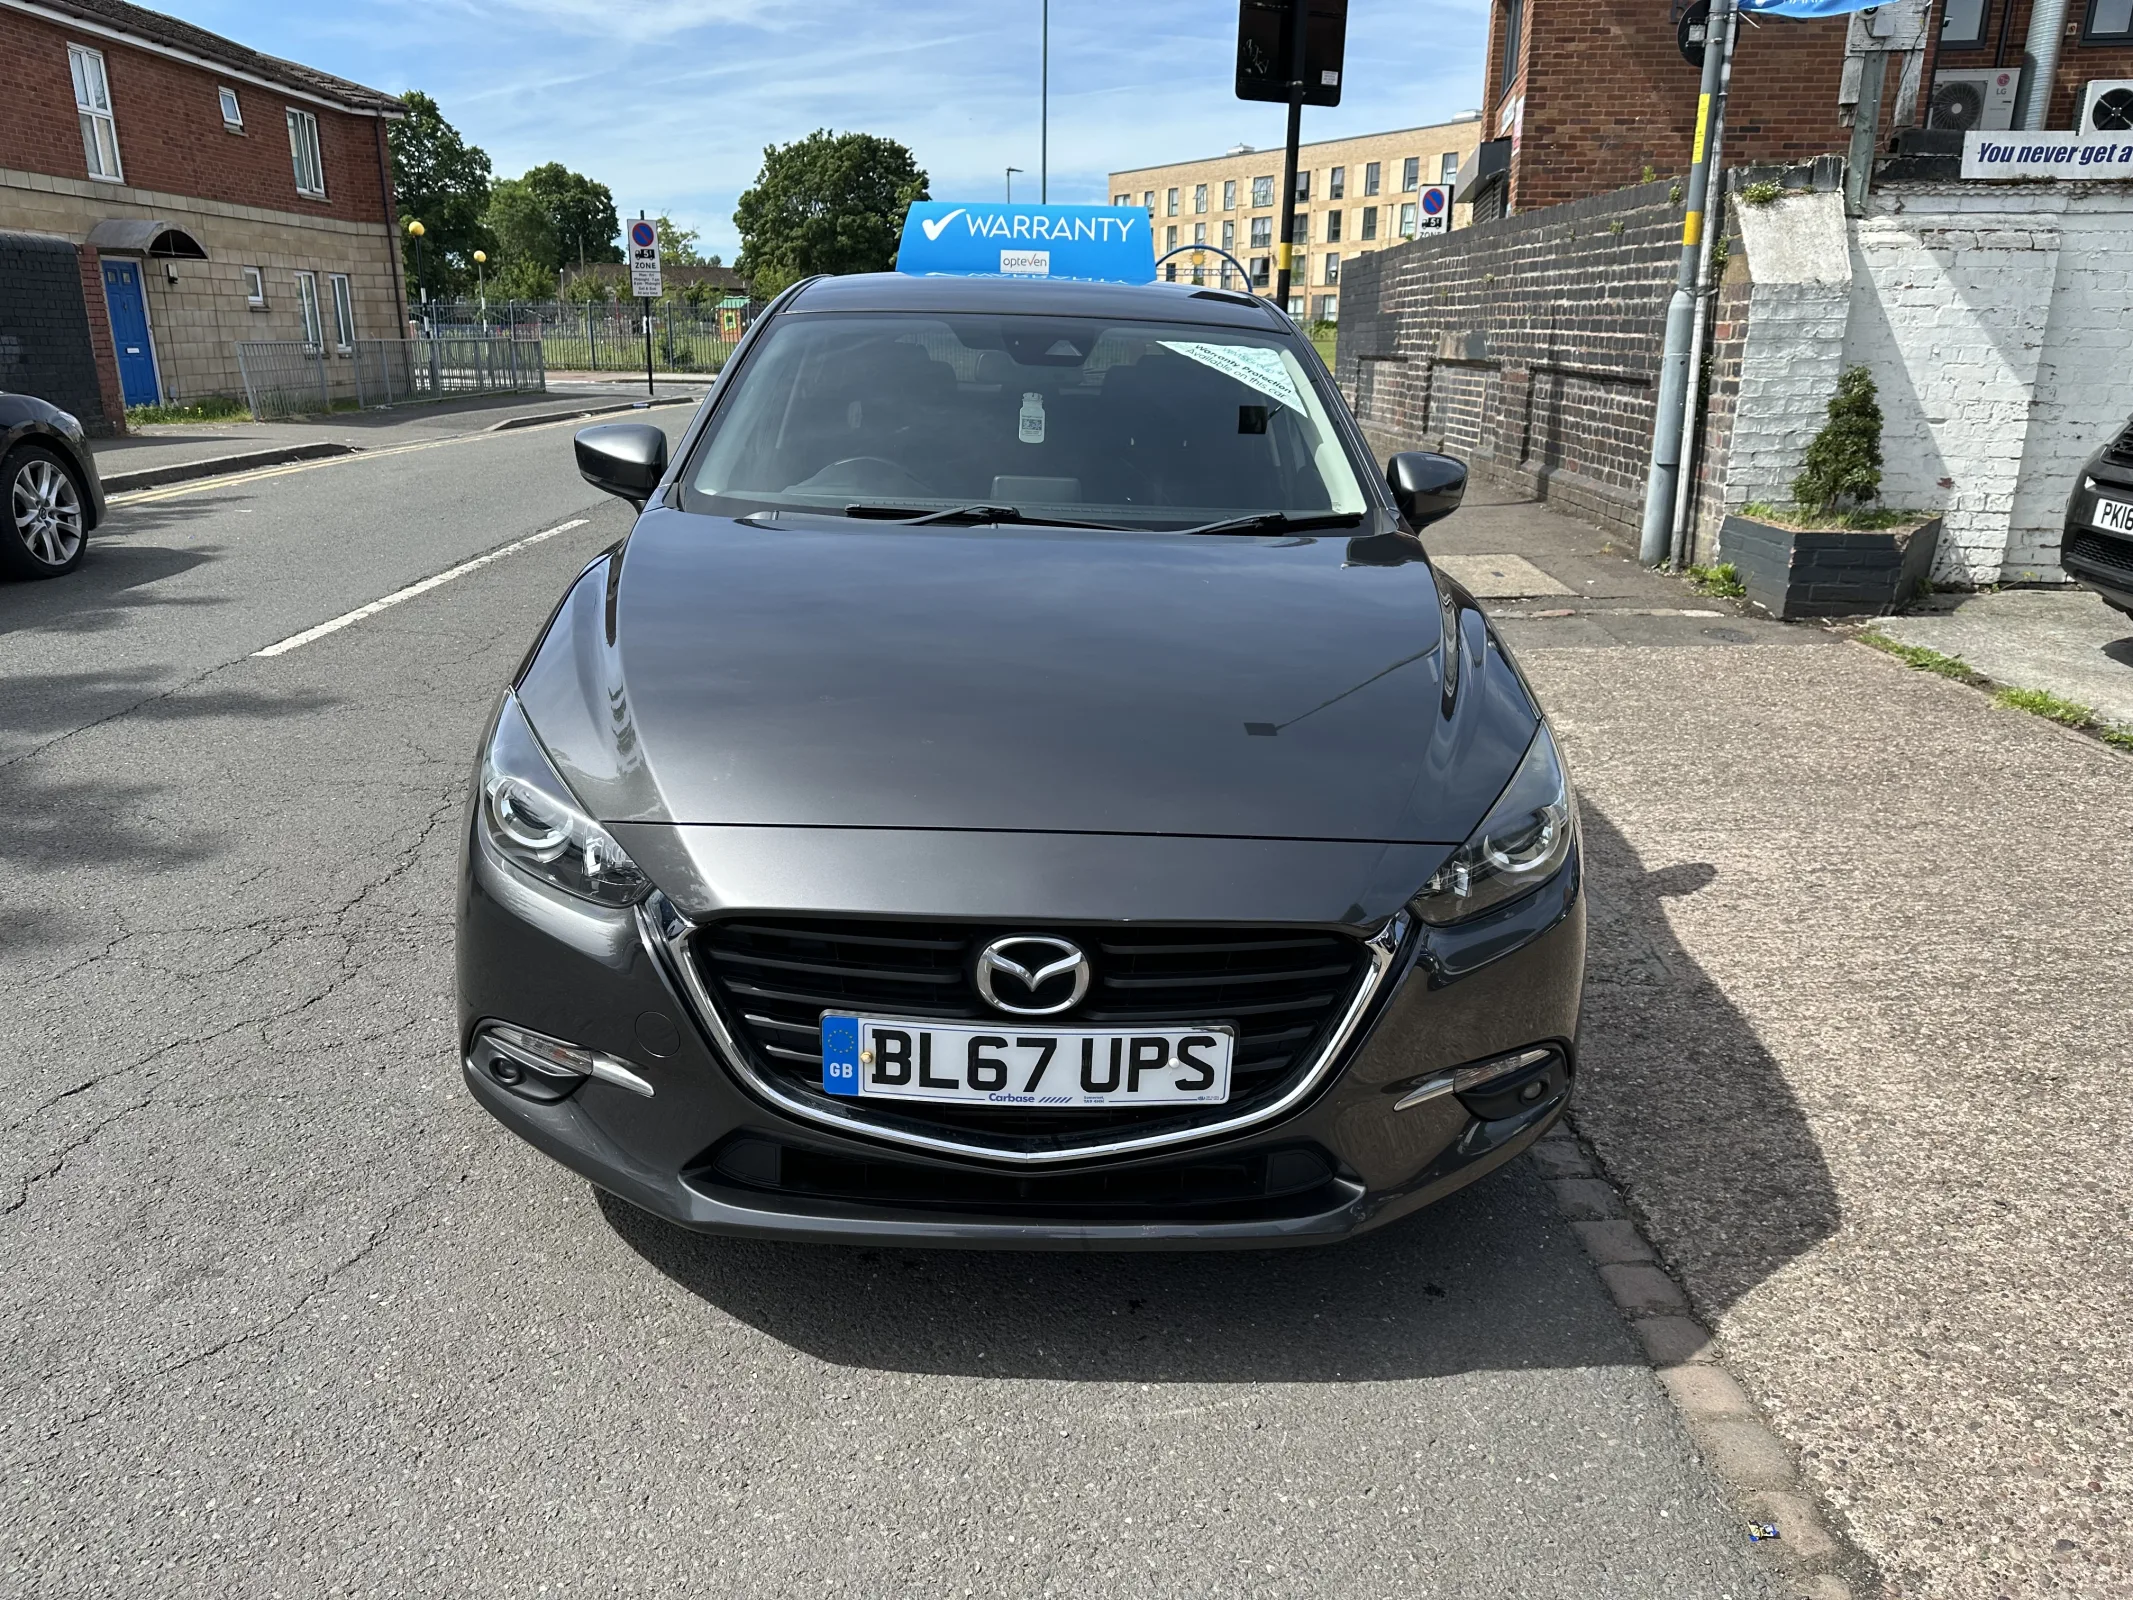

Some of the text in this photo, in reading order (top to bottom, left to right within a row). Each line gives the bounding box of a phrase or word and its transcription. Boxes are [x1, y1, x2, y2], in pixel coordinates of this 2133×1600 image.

[1978, 142, 2016, 163] You
[2016, 145, 2079, 163] never
[2079, 144, 2117, 166] get
[966, 213, 1135, 243] WARRANTY
[1003, 253, 1047, 268] opteven
[1186, 348, 1286, 399] Available on this car
[1195, 345, 1292, 394] Warranty Protection
[829, 1062, 853, 1078] GB
[872, 1028, 1217, 1093] BL67 UPS
[988, 1093, 1035, 1103] Carbase
